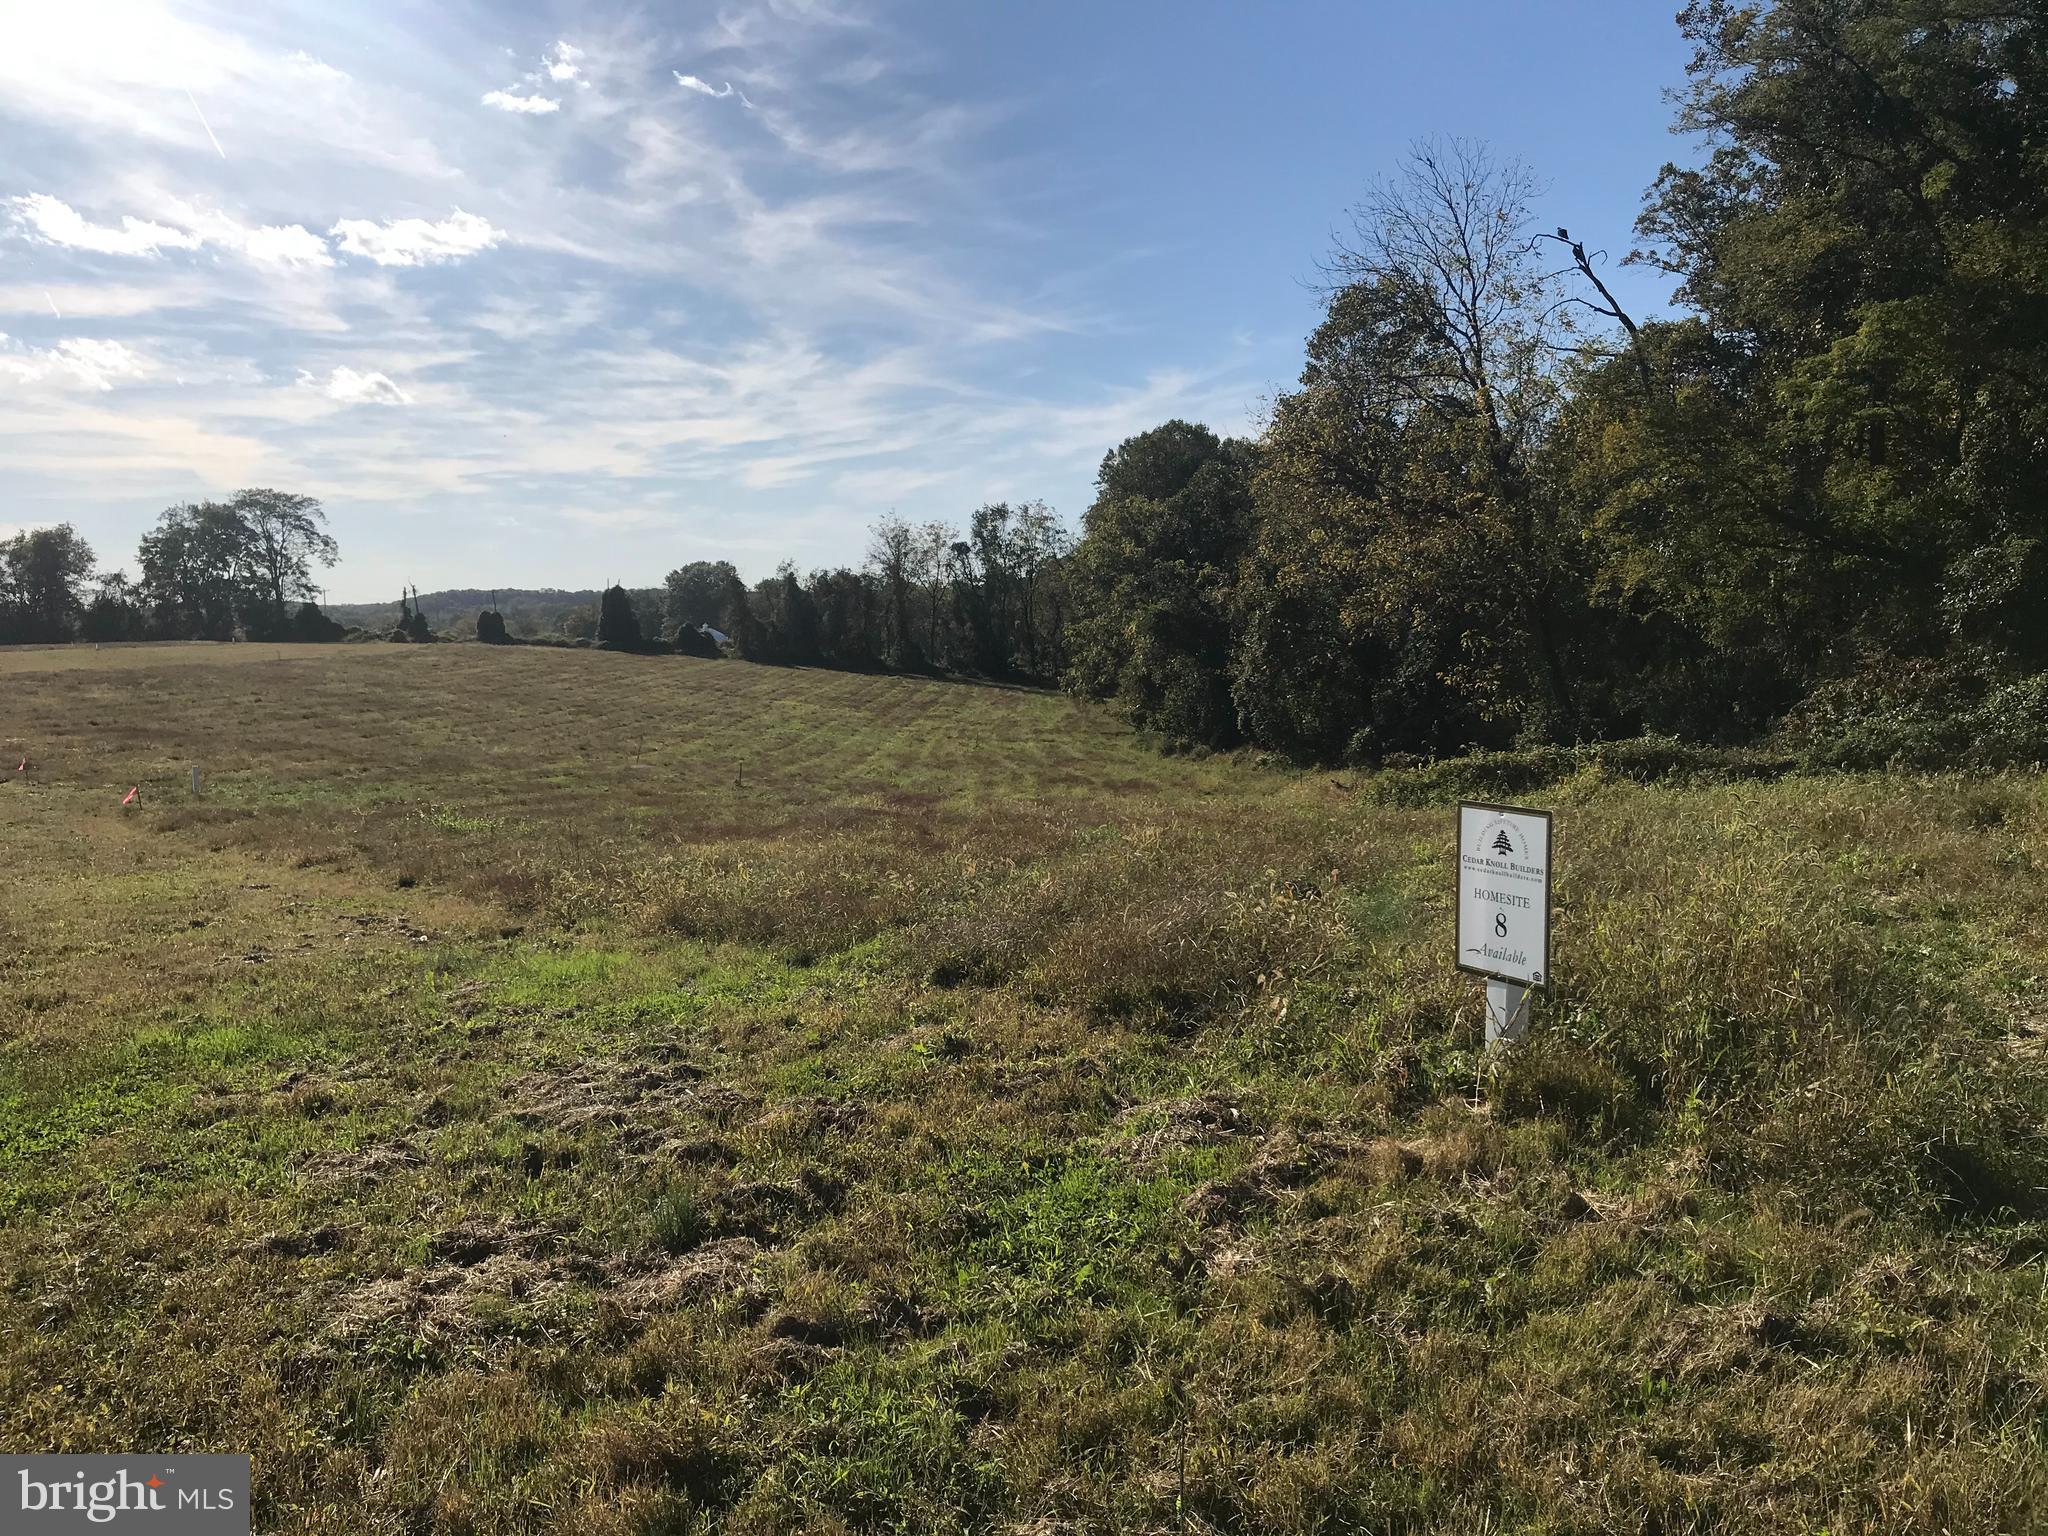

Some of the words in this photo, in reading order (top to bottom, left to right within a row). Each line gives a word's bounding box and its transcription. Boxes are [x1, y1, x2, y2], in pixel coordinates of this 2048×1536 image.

[1485, 858, 1510, 870] KNOLL
[1510, 862, 1544, 876] BUILDERS
[1474, 887, 1531, 909] HOMESITE
[1494, 912, 1508, 938] 8
[1478, 943, 1527, 966] Available
